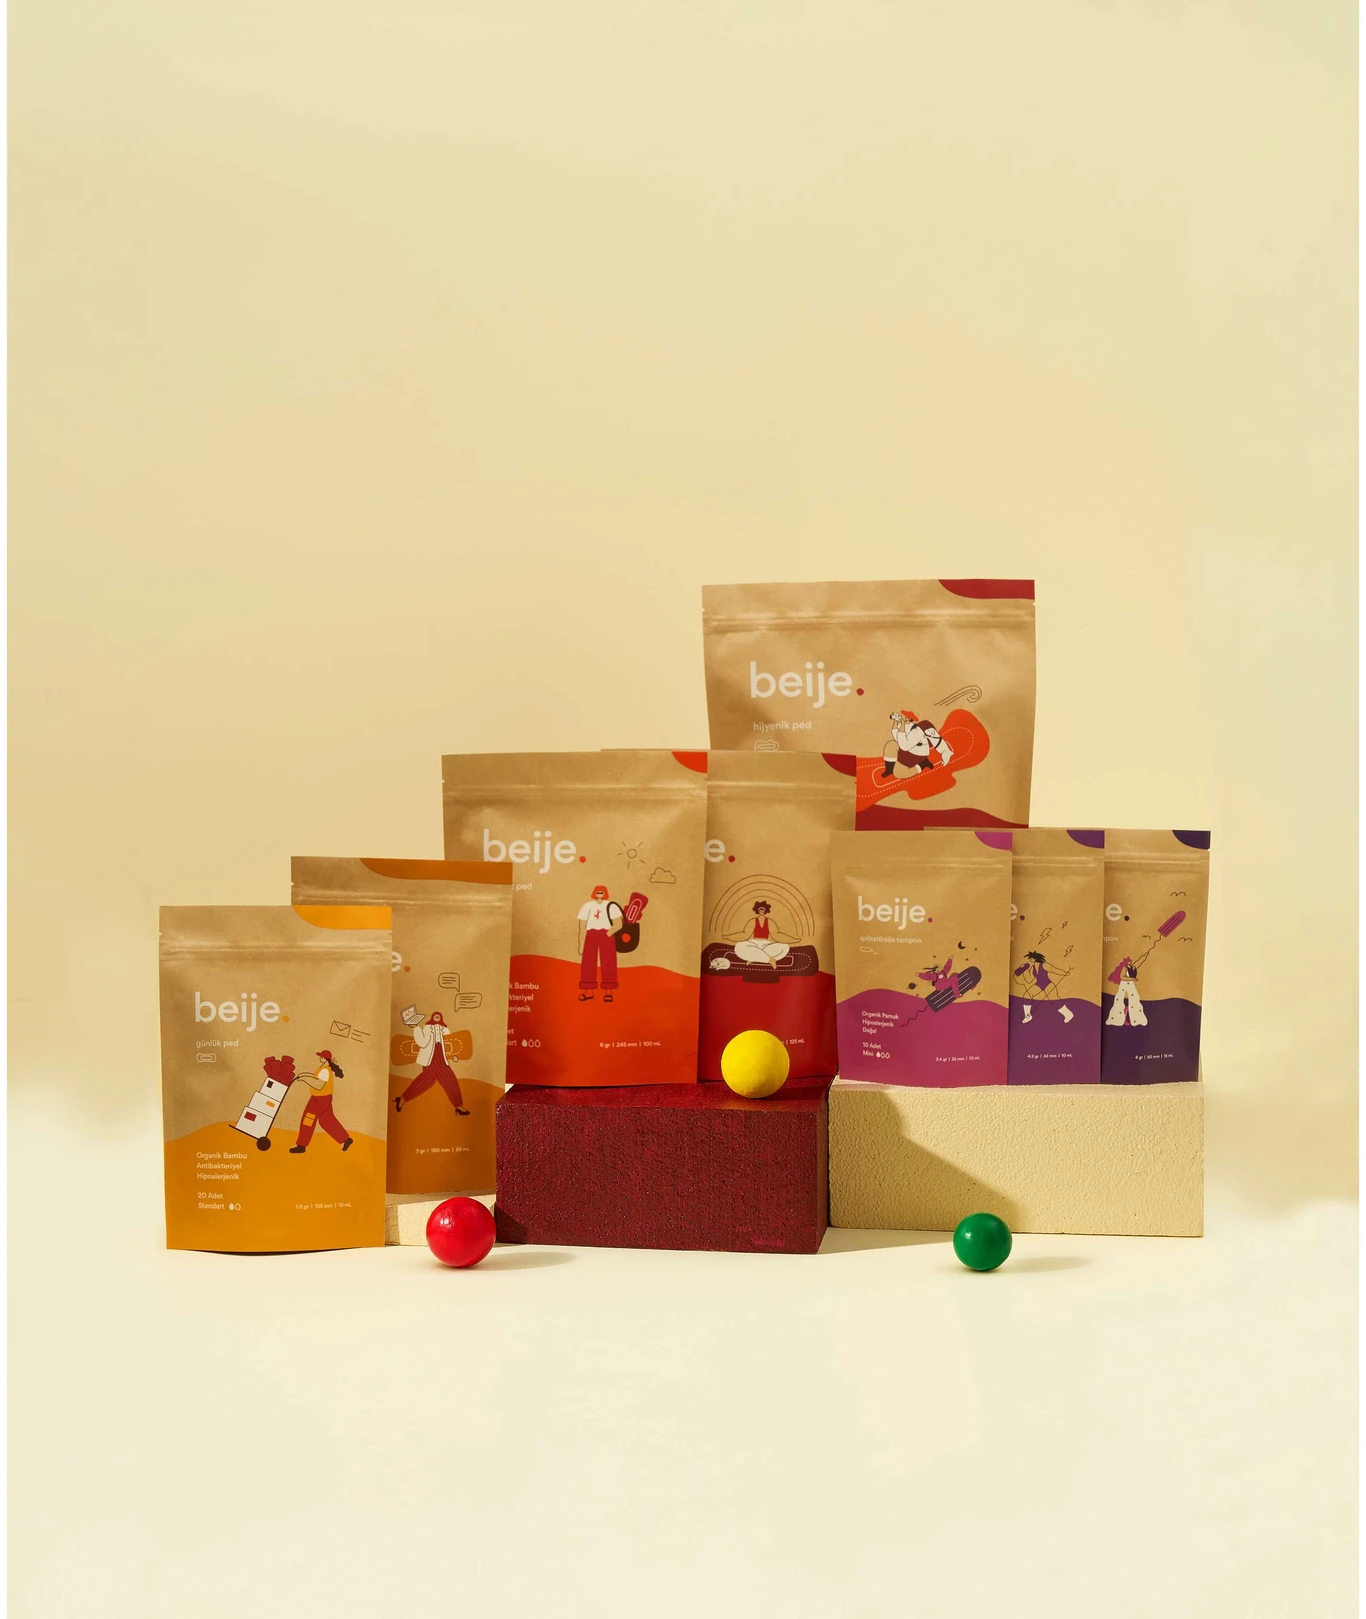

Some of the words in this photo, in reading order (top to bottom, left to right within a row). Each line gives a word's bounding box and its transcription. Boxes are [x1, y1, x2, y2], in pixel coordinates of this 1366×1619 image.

[750, 661, 864, 709] beije.
[753, 720, 790, 733] hijyenik
[792, 720, 812, 731] ped
[483, 829, 586, 874] beije.
[516, 883, 532, 891] ped
[858, 895, 933, 931] beije.
[195, 991, 290, 1032] beije.
[195, 1039, 222, 1049] günlük
[223, 1039, 239, 1048] ped
[196, 1152, 221, 1160] Organik
[196, 1162, 242, 1171] Antibakteriyel
[196, 1173, 239, 1181] Hipoalerjenik
